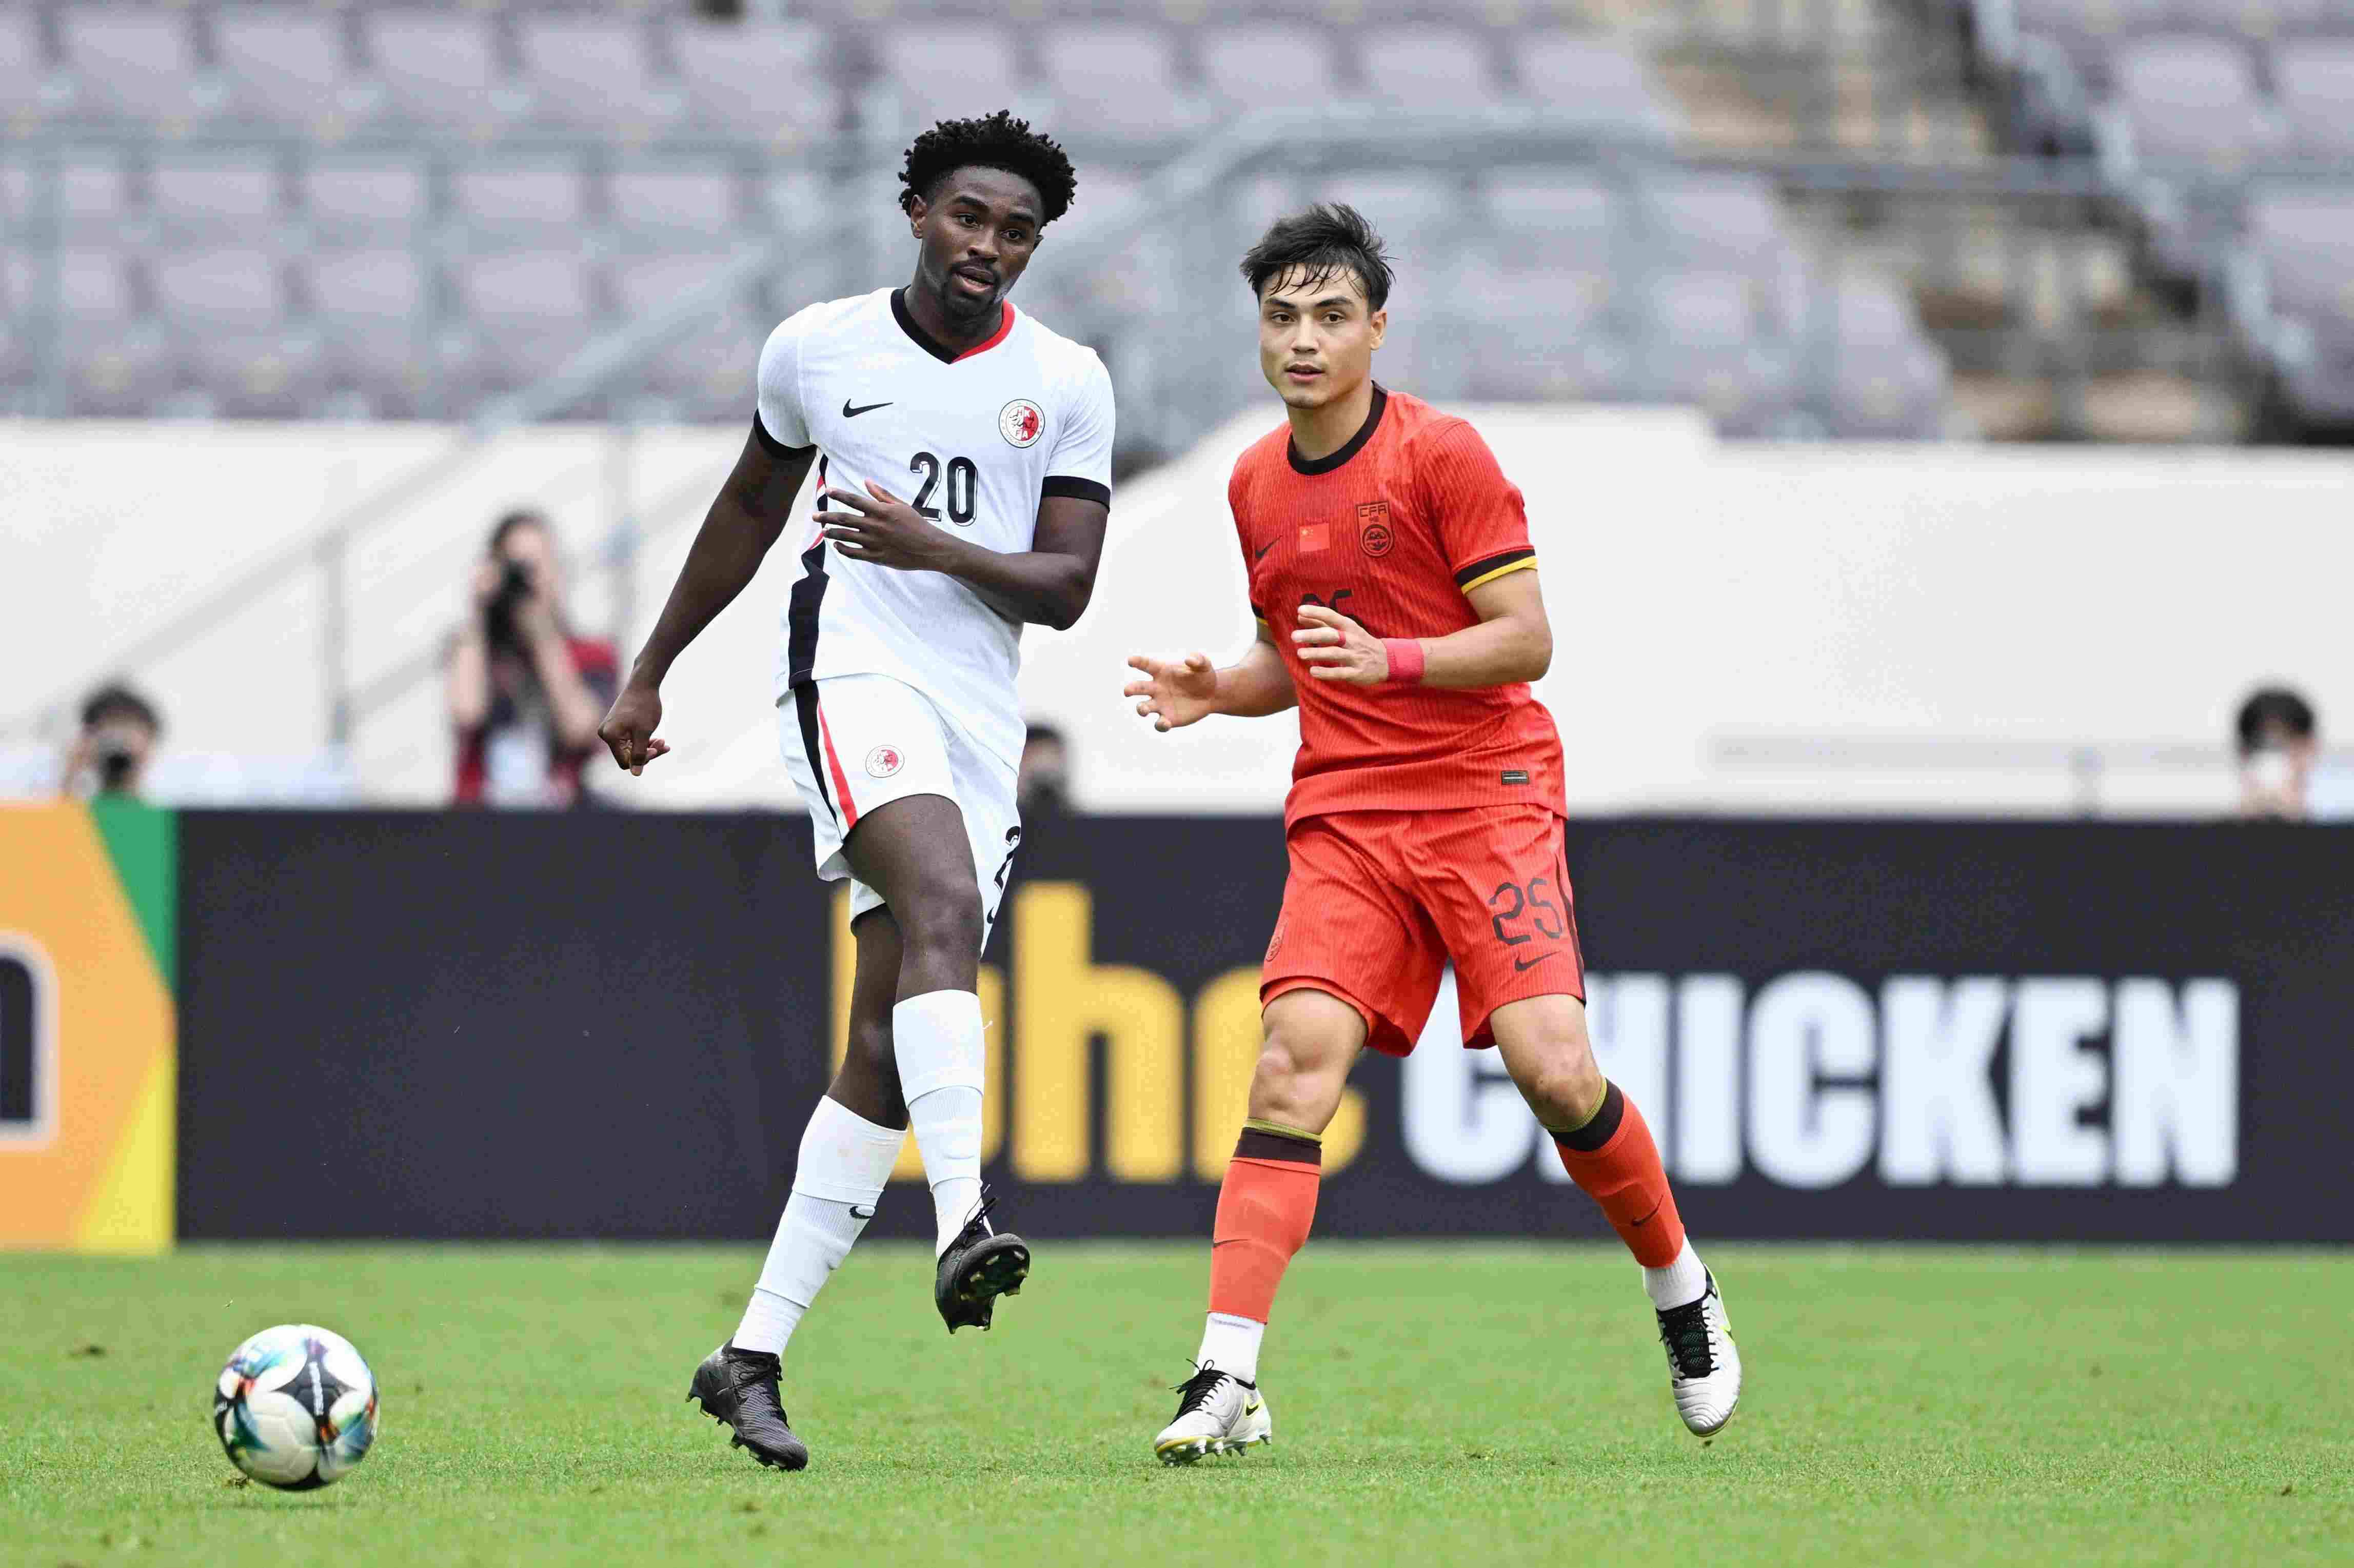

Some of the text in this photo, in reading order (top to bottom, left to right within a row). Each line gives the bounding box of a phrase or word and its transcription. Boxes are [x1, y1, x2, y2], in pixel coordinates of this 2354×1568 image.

[911, 451, 978, 526] 20
[1360, 505, 1387, 517] CFA
[1489, 878, 1562, 944] 25
